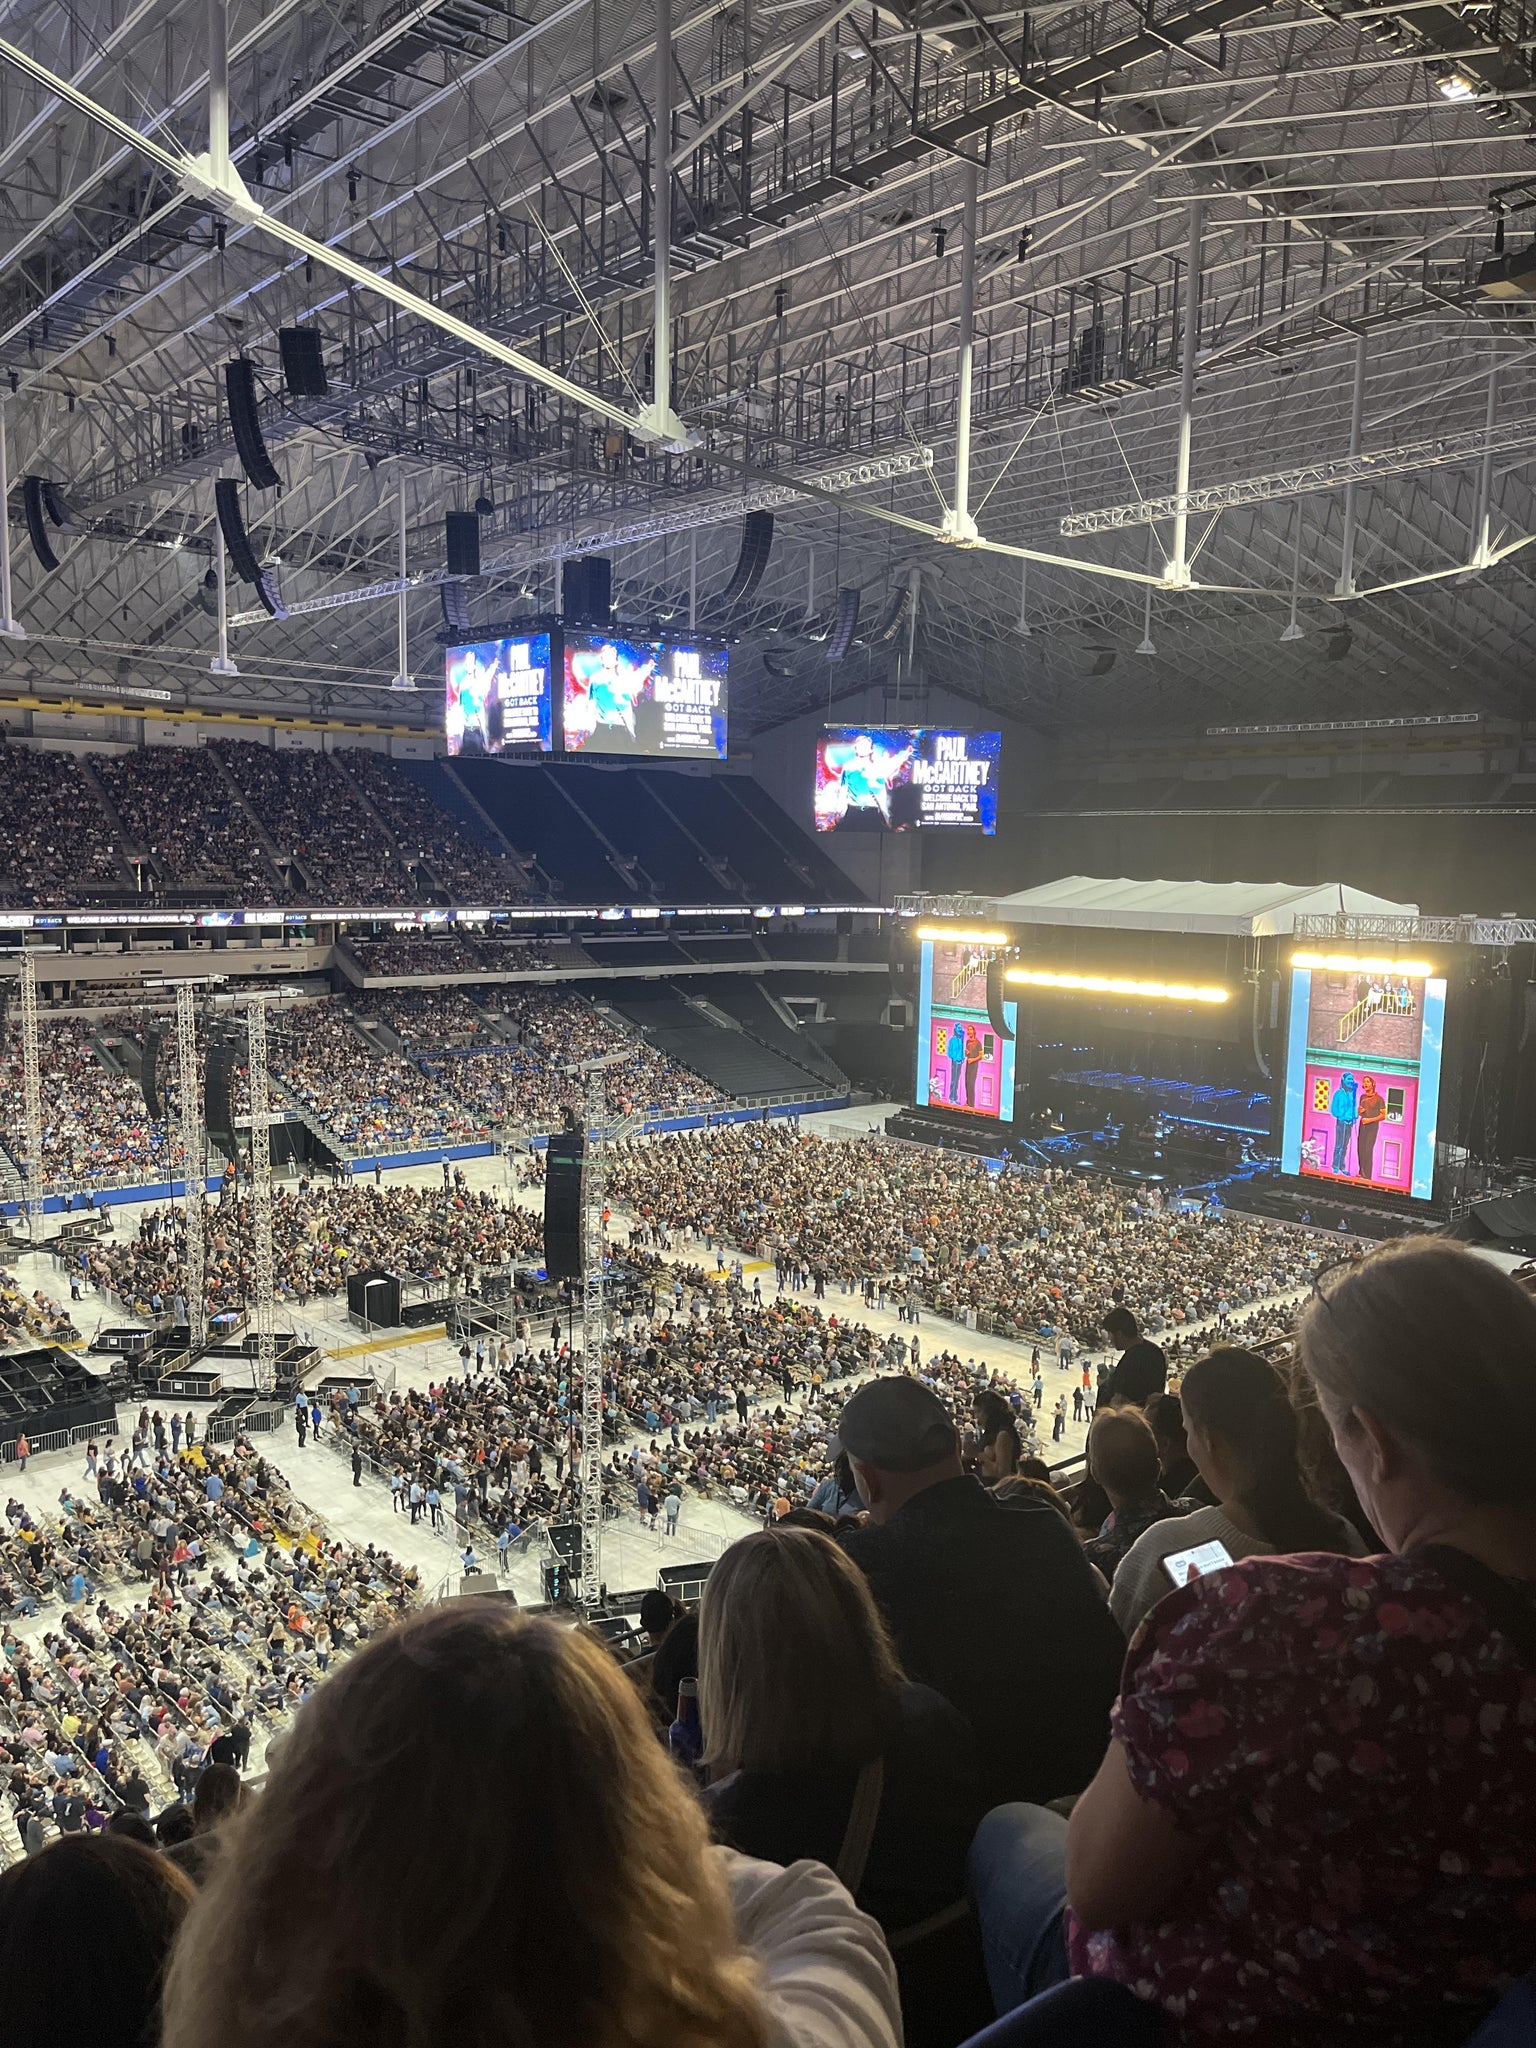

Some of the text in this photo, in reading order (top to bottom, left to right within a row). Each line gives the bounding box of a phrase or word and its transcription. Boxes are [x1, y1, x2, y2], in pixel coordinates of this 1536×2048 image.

[519, 697, 538, 706] BACK
[665, 703, 711, 714] GOT BACK
[936, 736, 968, 761] PAUL
[913, 760, 990, 785] McCARTNEY
[924, 784, 977, 793] GOT BACK
[66, 916, 99, 924] WELCOME
[100, 916, 117, 924] BACK
